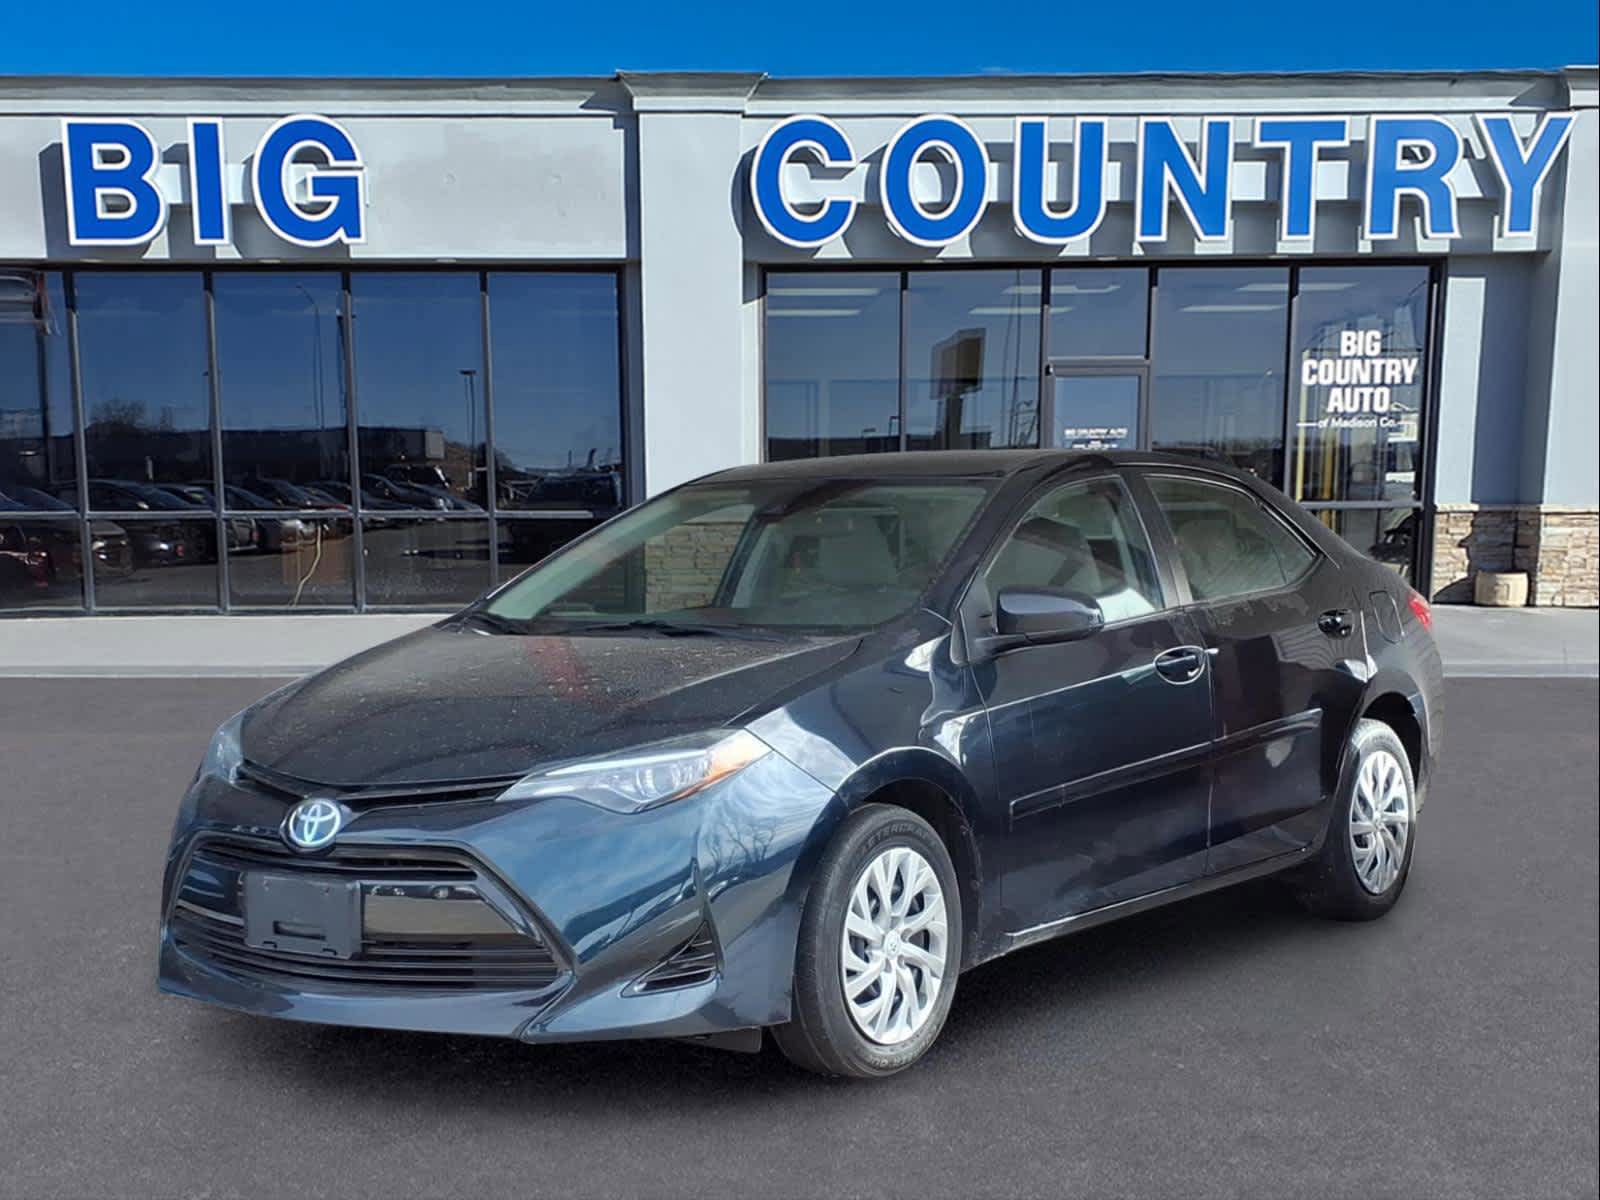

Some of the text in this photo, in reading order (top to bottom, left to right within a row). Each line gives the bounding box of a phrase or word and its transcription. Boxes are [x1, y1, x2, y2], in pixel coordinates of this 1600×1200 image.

[61, 112, 1578, 249] BIG COUNTRY
[1340, 329, 1382, 357] BIG
[1302, 357, 1419, 386] COUNTRY
[1326, 386, 1392, 413] AUTO
[1317, 418, 1329, 428] of
[1331, 417, 1378, 428] Madison
